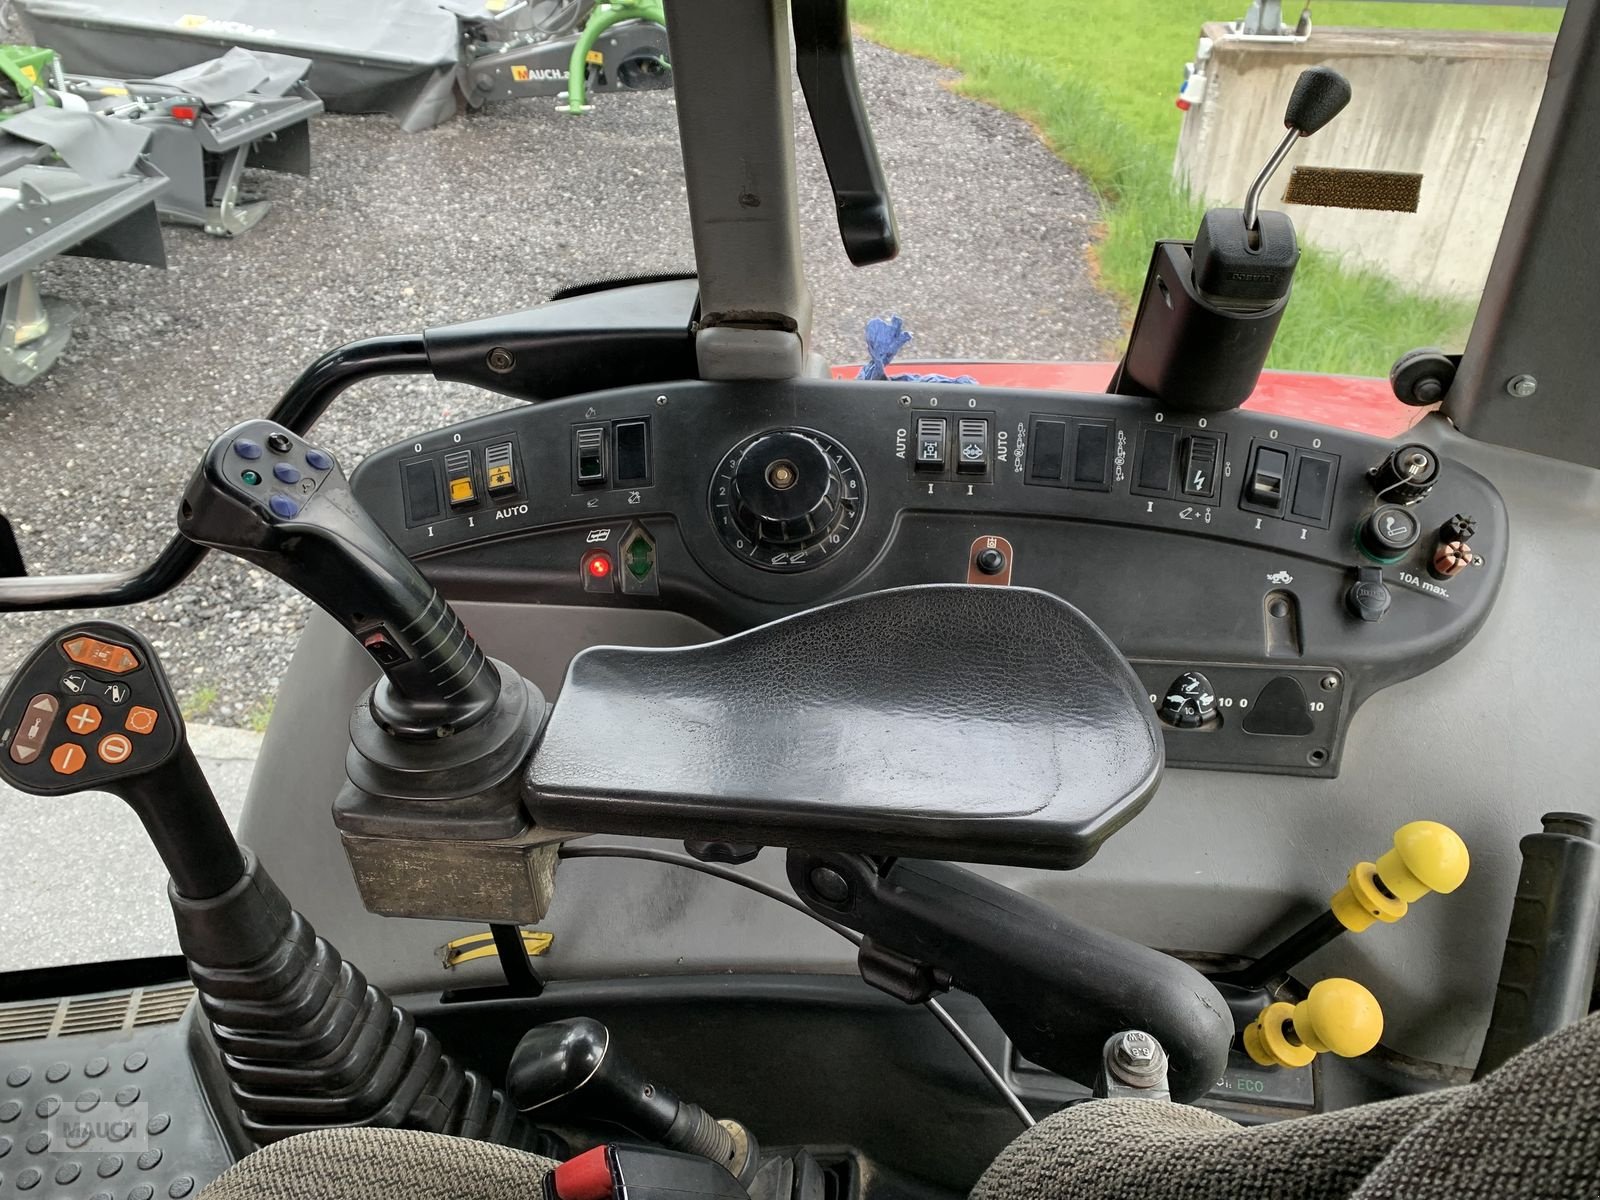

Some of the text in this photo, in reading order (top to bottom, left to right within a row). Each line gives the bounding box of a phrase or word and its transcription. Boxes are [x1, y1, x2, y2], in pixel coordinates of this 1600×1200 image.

[895, 428, 907, 459] AUTO
[997, 431, 1008, 462] AUTO
[729, 459, 736, 469] 3
[836, 455, 843, 464] 7
[849, 479, 857, 489] 8
[719, 486, 726, 496] 2
[495, 504, 529, 520] AUTO
[736, 539, 744, 549] 0
[829, 534, 840, 544] 10
[1399, 571, 1450, 598] 10A max.
[1218, 697, 1233, 707] 10
[1239, 698, 1248, 708] 0
[1309, 702, 1324, 712] 10
[1185, 706, 1194, 715] 10
[1237, 1078, 1264, 1093] ECO
